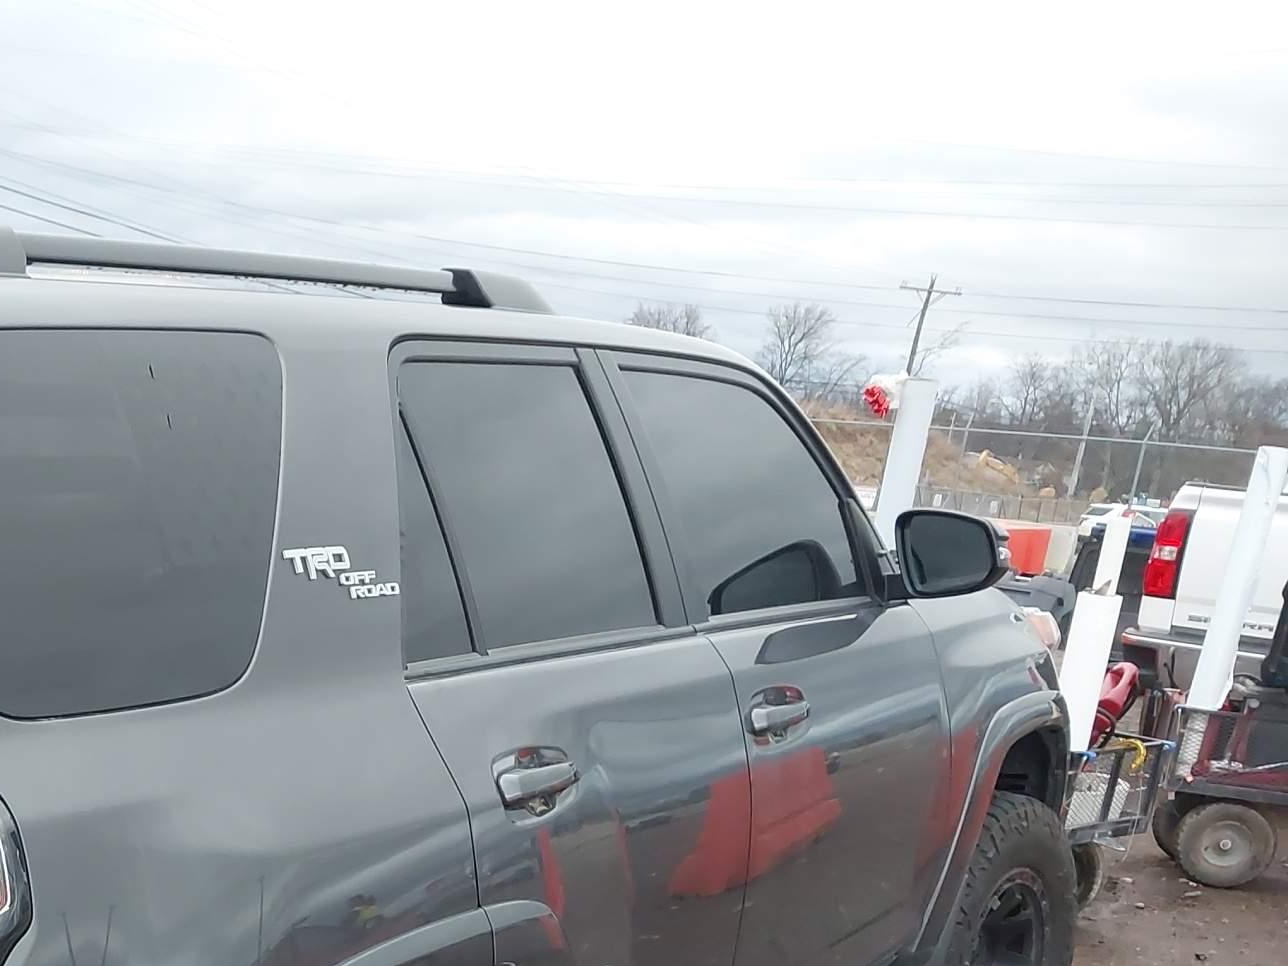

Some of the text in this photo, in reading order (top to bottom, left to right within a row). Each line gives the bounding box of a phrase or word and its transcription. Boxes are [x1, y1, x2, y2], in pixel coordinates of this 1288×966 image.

[282, 545, 351, 580] TRD
[339, 570, 376, 586] OFF
[349, 582, 401, 600] ROAD
